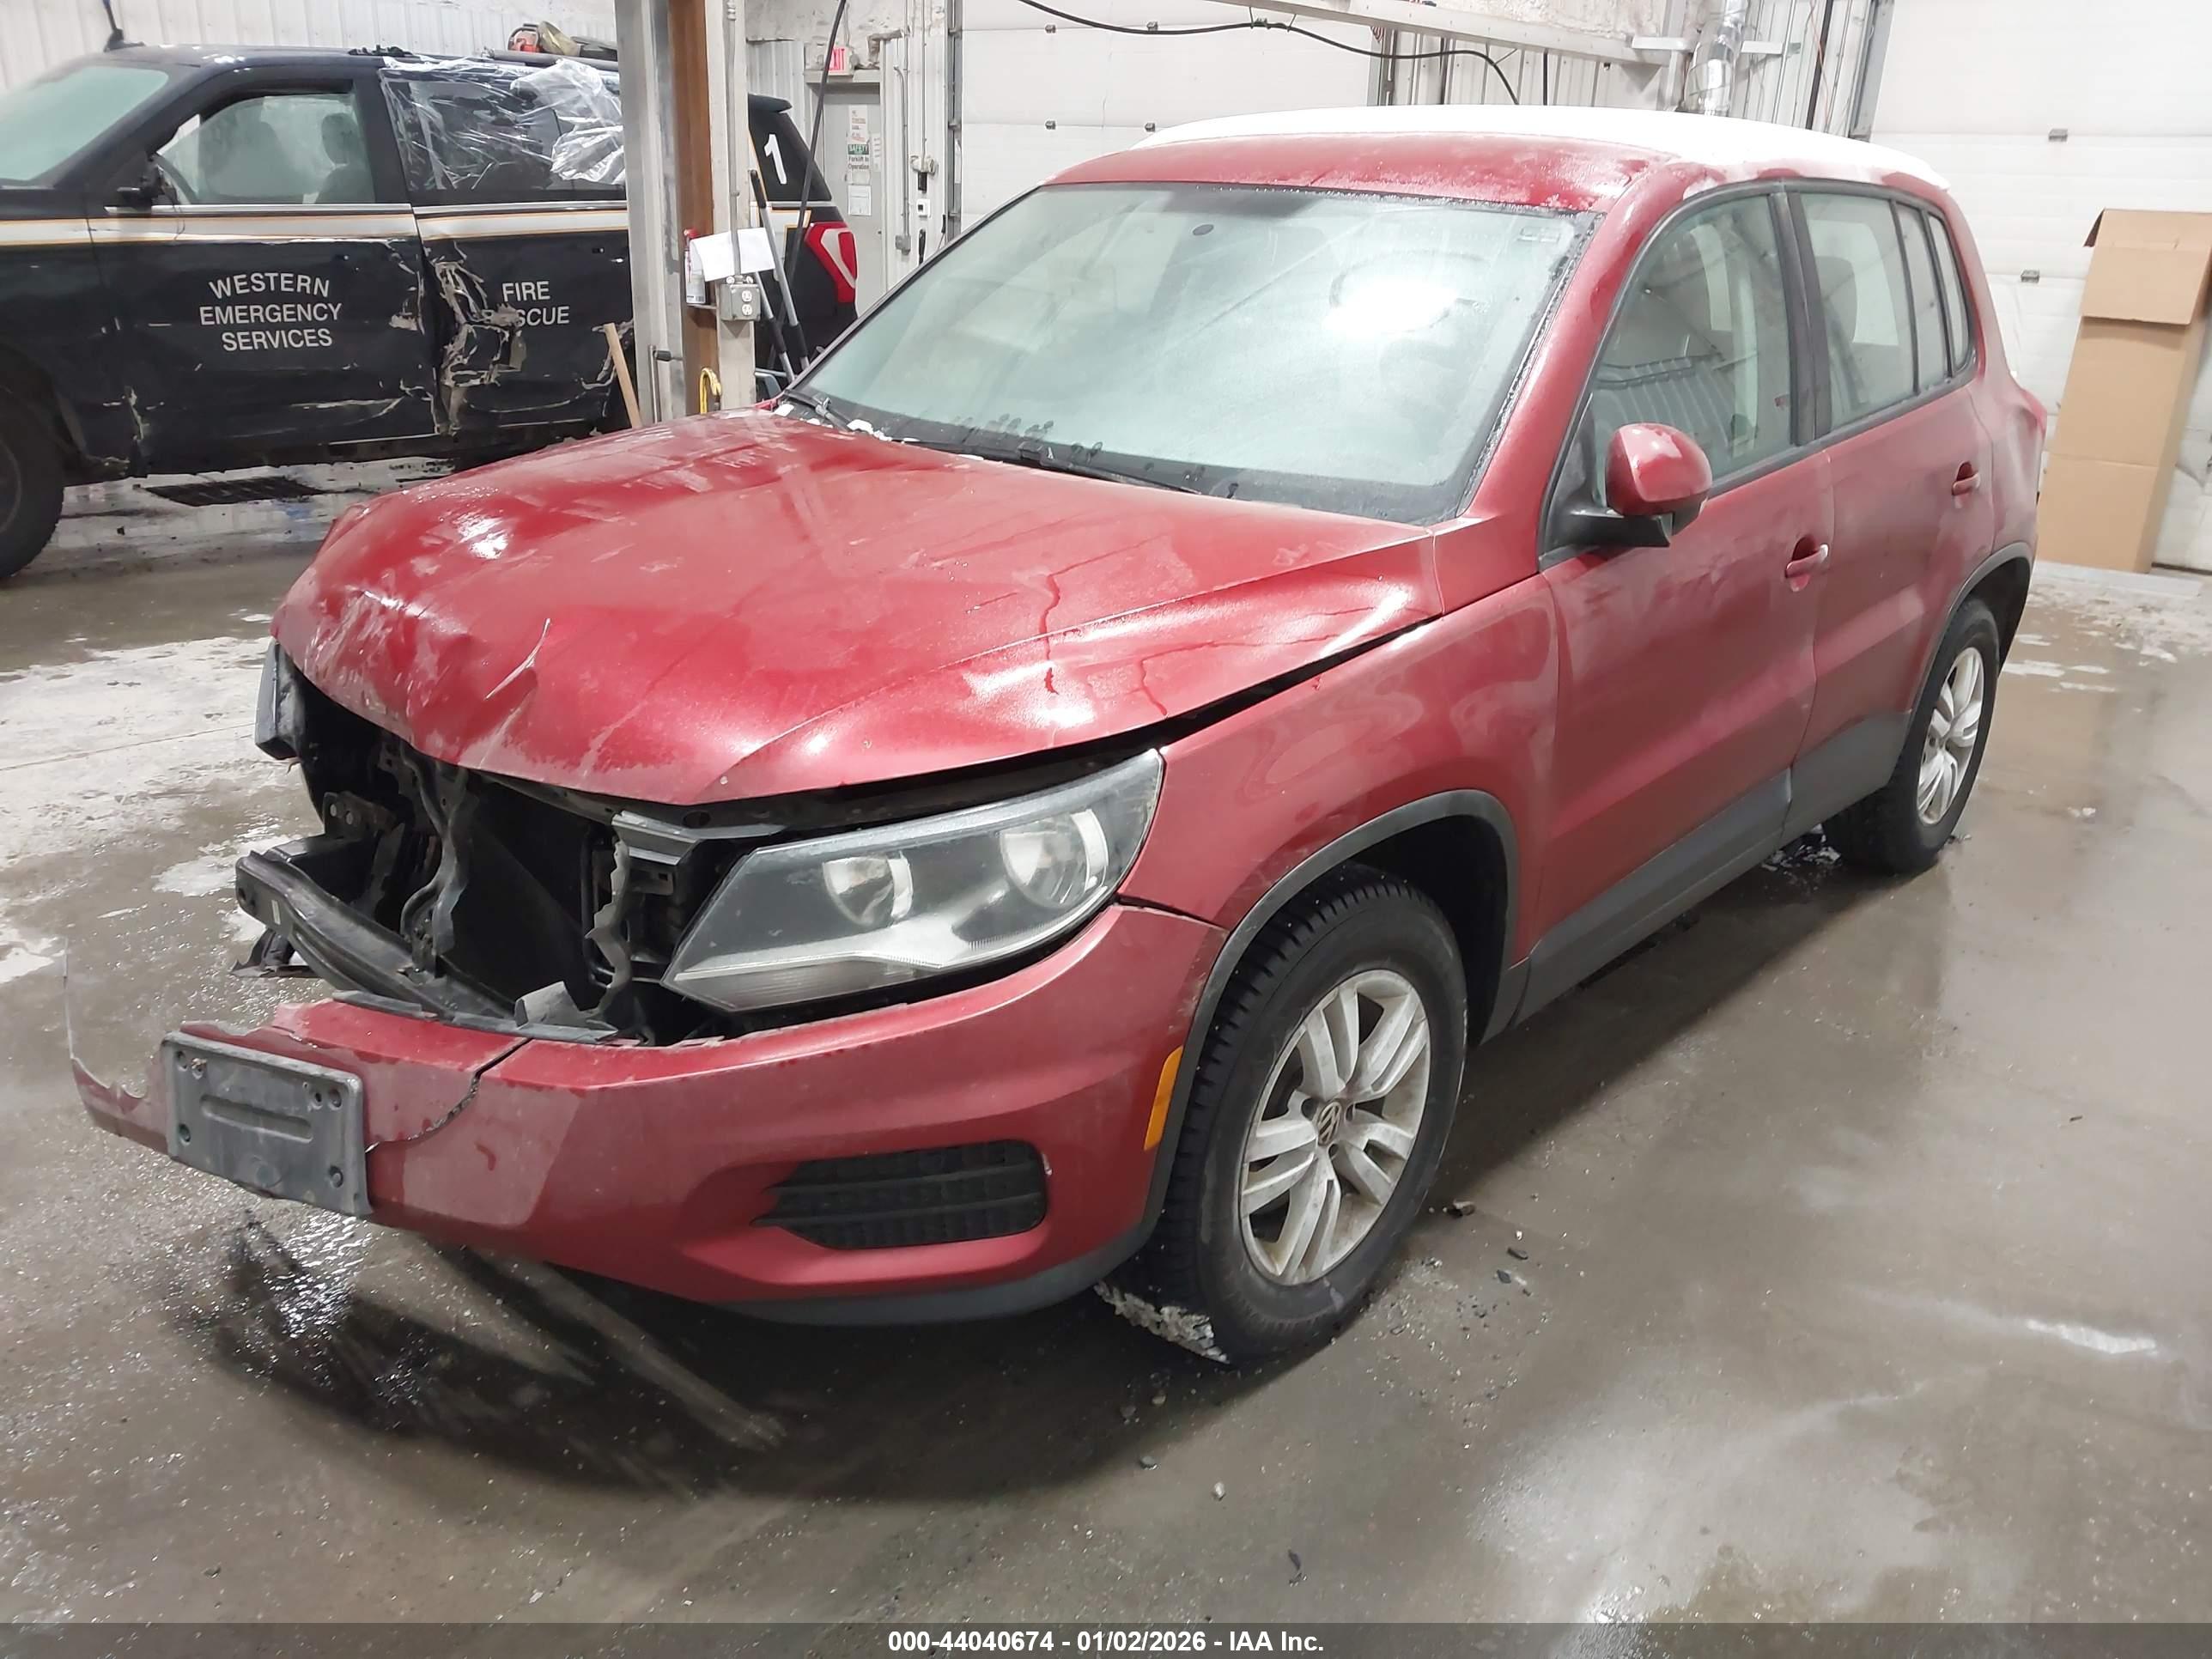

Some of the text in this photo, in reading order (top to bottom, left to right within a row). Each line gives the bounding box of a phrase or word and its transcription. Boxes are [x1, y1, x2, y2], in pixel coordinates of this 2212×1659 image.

[764, 133, 787, 185] 1
[209, 272, 330, 300] WESTERN
[501, 280, 550, 302] FIRE
[199, 302, 343, 325] EMERGENCY
[515, 306, 570, 326] SCUE
[222, 328, 333, 351] SERVICES
